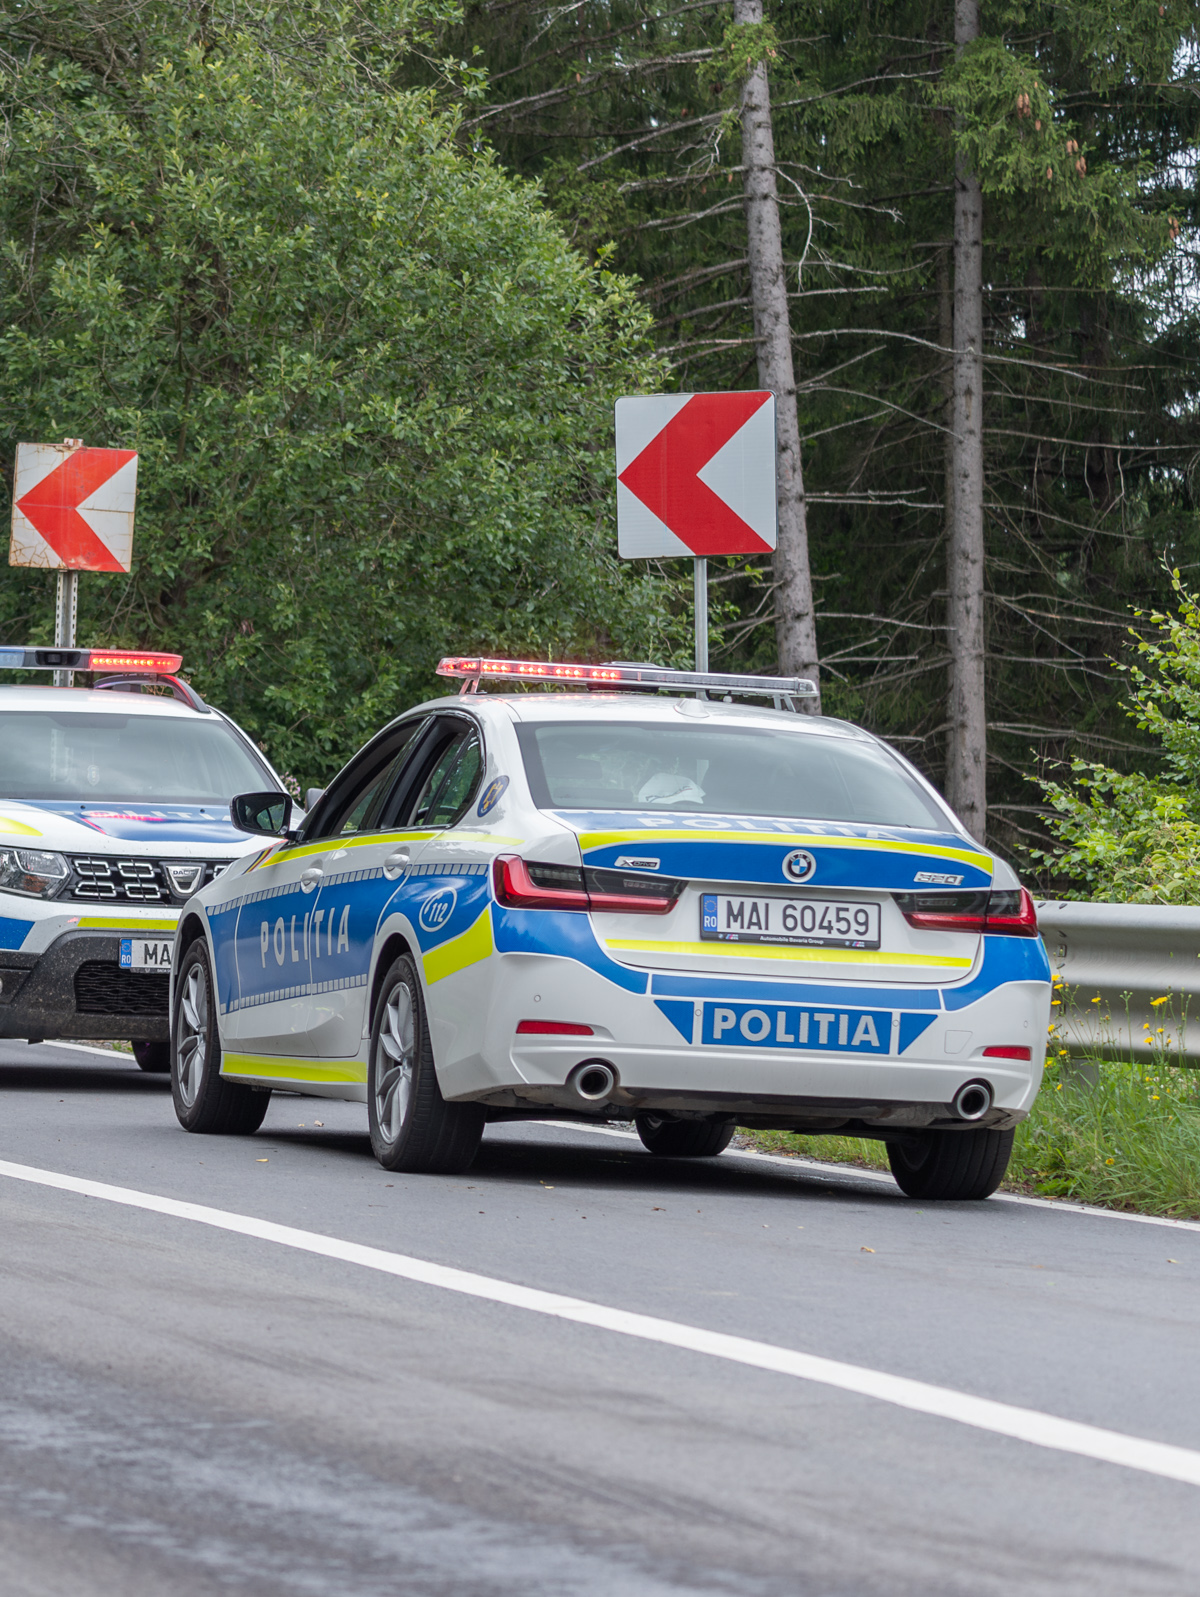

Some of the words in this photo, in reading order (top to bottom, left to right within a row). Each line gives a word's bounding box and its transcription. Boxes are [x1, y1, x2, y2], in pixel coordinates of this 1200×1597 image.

[637, 817, 910, 843] POLITIA
[428, 902, 449, 923] 112
[704, 915, 717, 928] RO
[726, 900, 770, 931] MAI
[782, 904, 870, 937] 60459
[260, 904, 351, 969] POLITIA
[121, 954, 131, 964] RO
[713, 1007, 881, 1047] POLITIA
